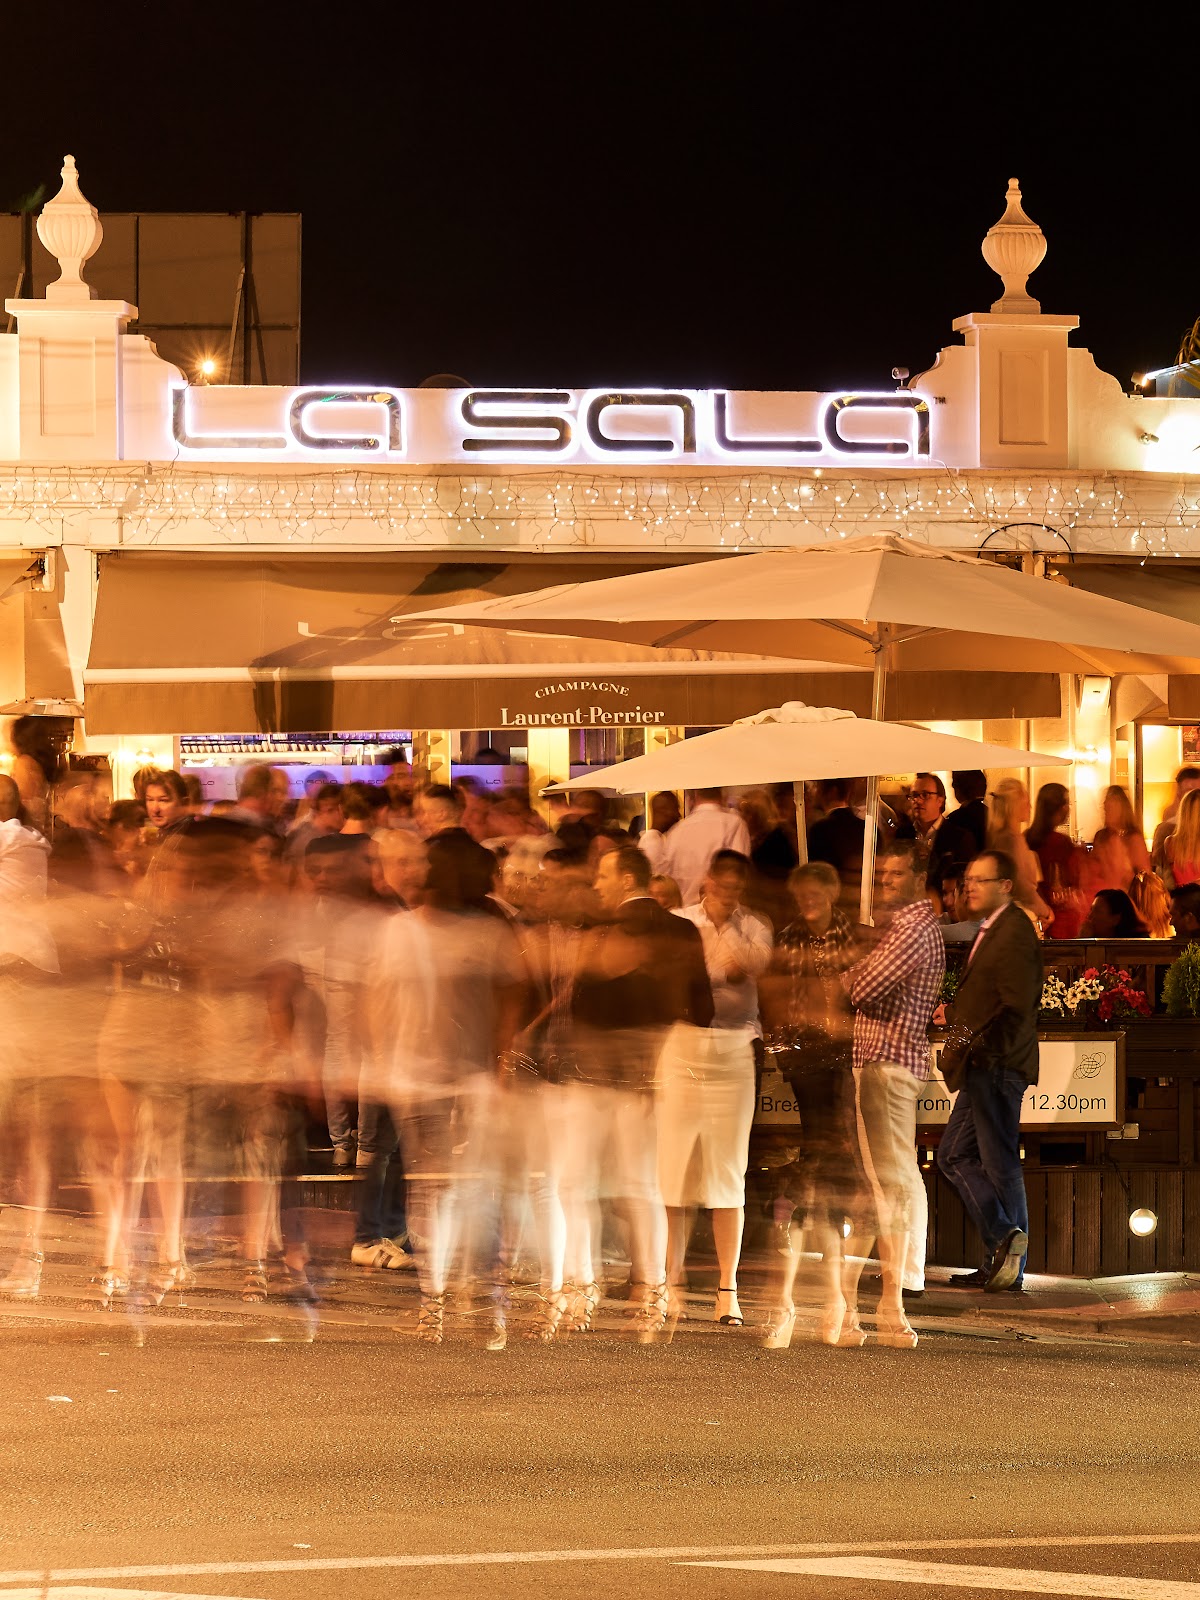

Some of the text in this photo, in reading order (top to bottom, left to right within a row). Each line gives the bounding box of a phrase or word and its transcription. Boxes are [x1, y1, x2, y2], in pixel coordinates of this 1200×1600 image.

[534, 681, 630, 699] CHAMPAGNE
[500, 705, 666, 726] Laurent-Perrier
[916, 1098, 951, 1111] rom
[1028, 1094, 1107, 1114] 12.30pm
